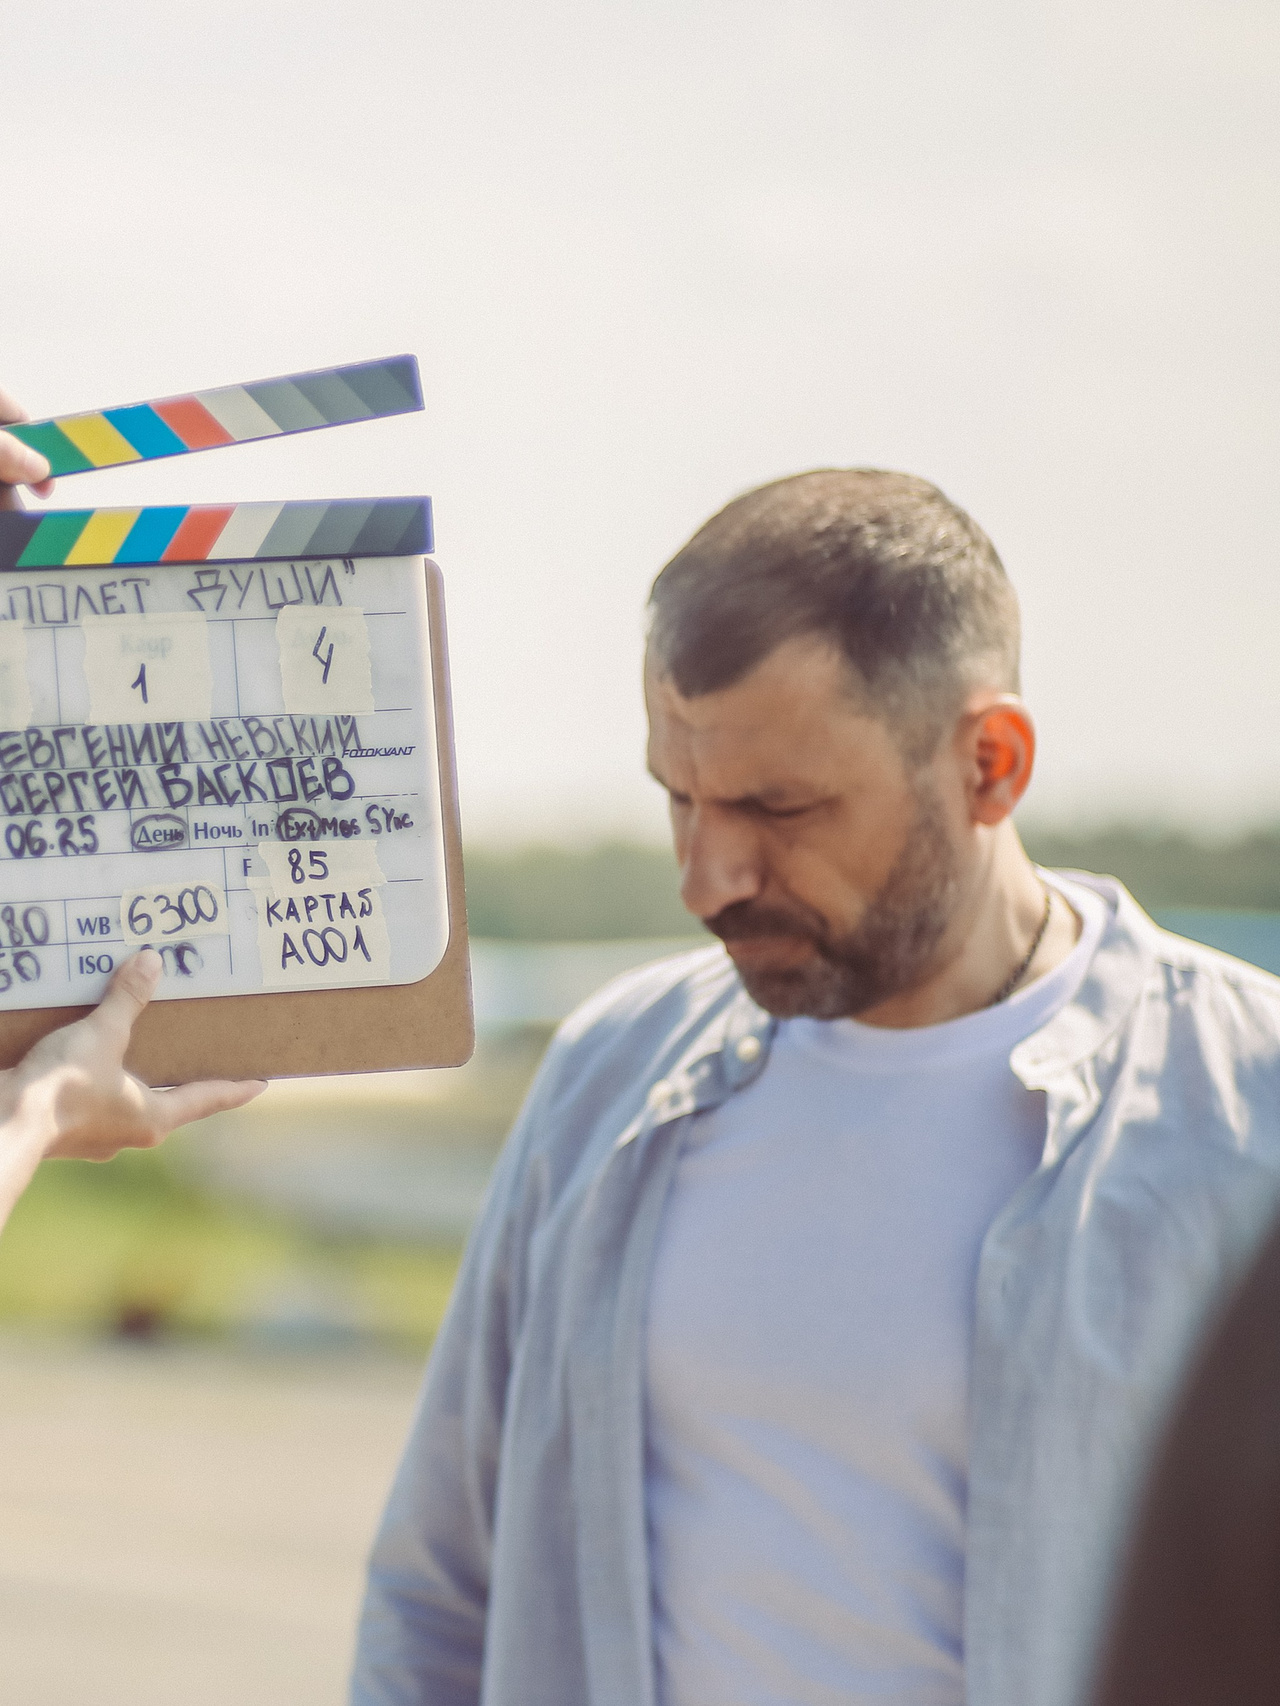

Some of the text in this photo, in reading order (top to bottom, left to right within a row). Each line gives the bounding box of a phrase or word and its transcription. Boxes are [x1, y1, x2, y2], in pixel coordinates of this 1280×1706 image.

[312, 625, 335, 685] 4
[130, 662, 149, 704] 1
[197, 714, 362, 762] НЕВСКИЙ
[341, 745, 417, 759] FOTOKVANT
[136, 821, 243, 846] День Ночь
[243, 858, 252, 877] F
[287, 847, 330, 885] 85
[128, 885, 219, 936] 6300
[76, 916, 112, 937] WB
[78, 954, 114, 975] ISO
